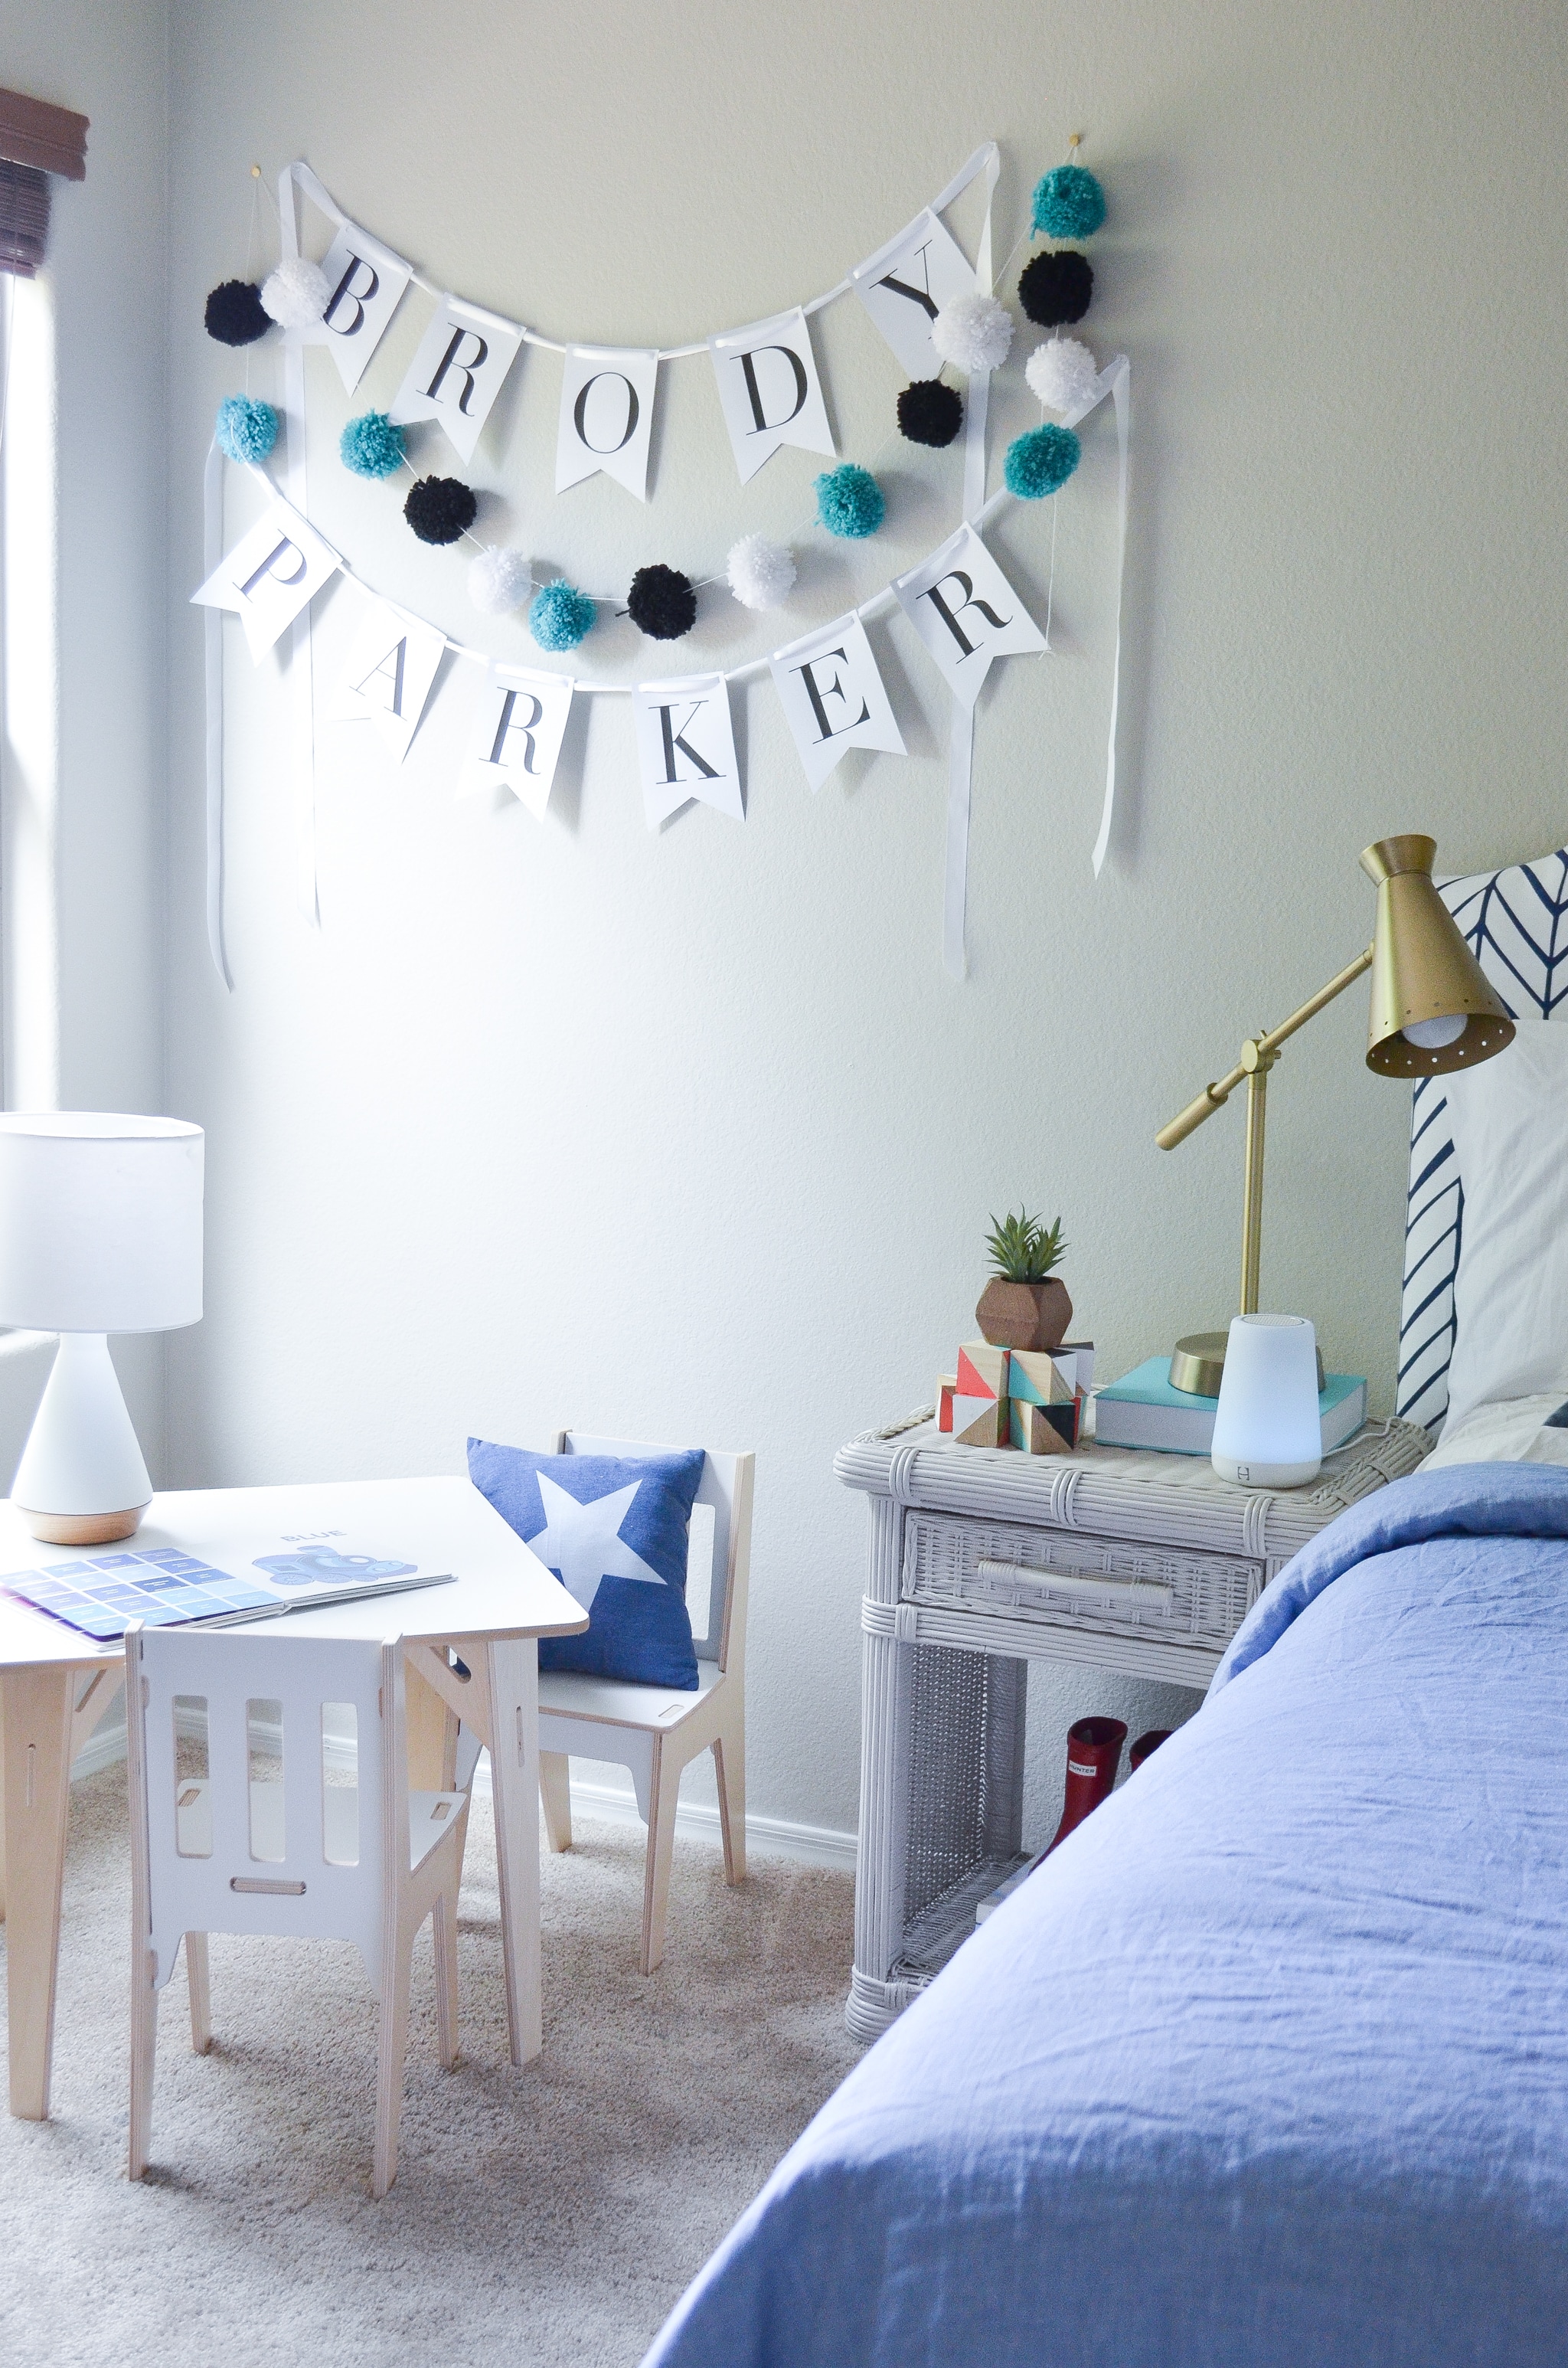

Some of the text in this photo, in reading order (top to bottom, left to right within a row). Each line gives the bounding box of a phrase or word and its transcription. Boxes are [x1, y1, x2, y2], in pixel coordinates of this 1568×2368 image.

[320, 240, 940, 453] BRODY
[233, 528, 1013, 784] PARKER
[280, 1530, 347, 1542] BLUE
[1070, 1764, 1095, 1773] HUNTER
